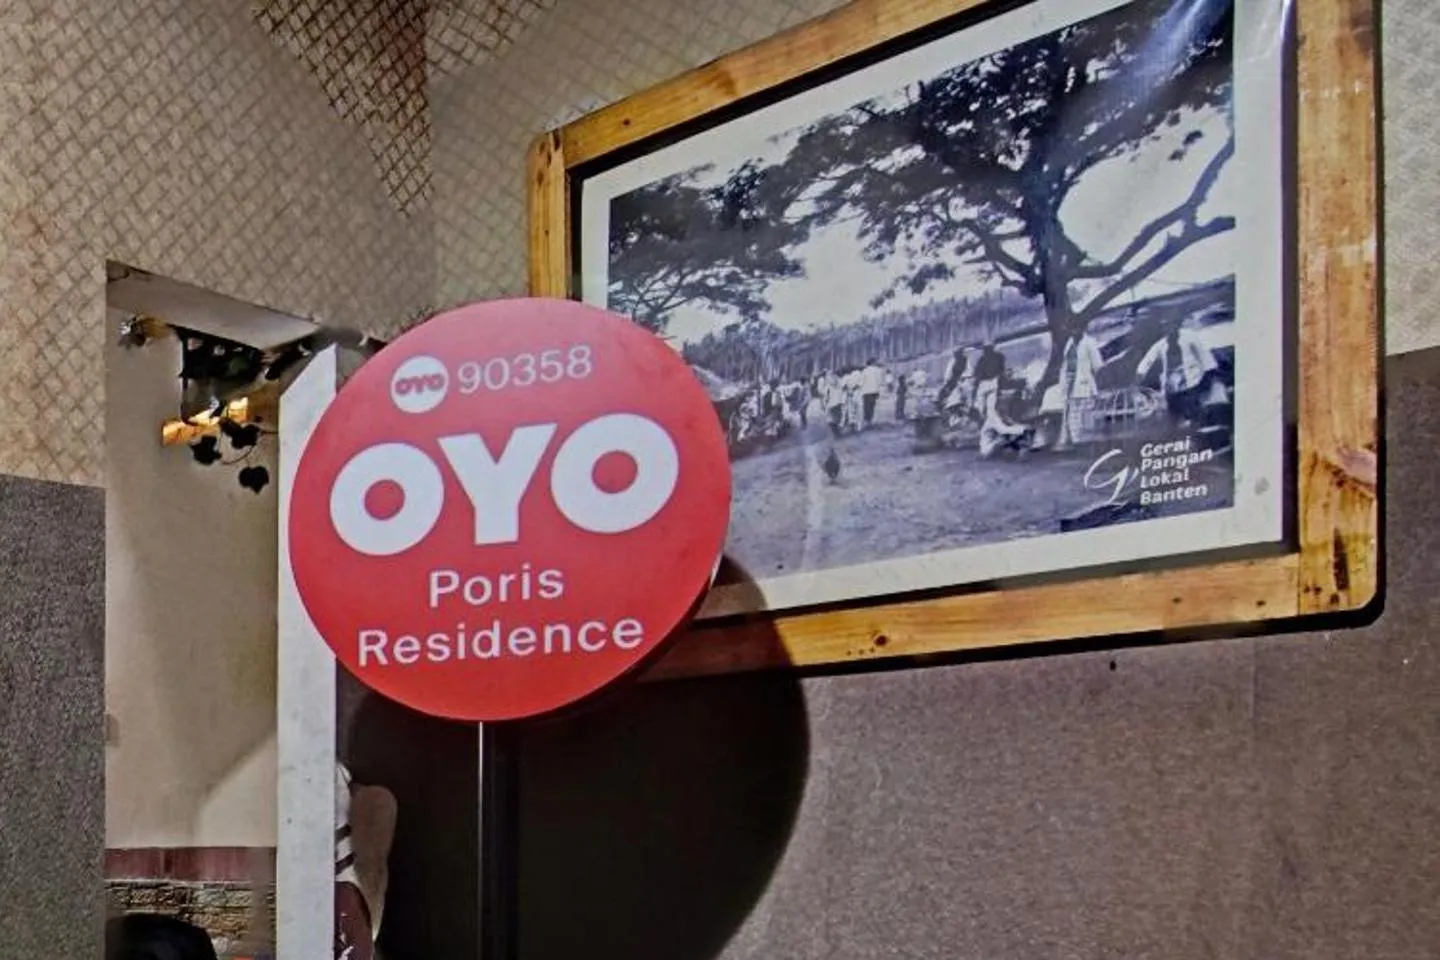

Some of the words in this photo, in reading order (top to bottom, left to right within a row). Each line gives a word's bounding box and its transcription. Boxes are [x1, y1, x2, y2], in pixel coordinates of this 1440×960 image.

[395, 374, 445, 395] OYO
[458, 345, 592, 393] 90358
[1140, 436, 1191, 457] Gerai
[1140, 448, 1213, 472] Pangan
[329, 412, 680, 557] OYO
[1140, 468, 1190, 488] Lokal
[1140, 483, 1207, 505] Banten
[429, 563, 564, 607] Poris
[358, 616, 645, 667] Residence
